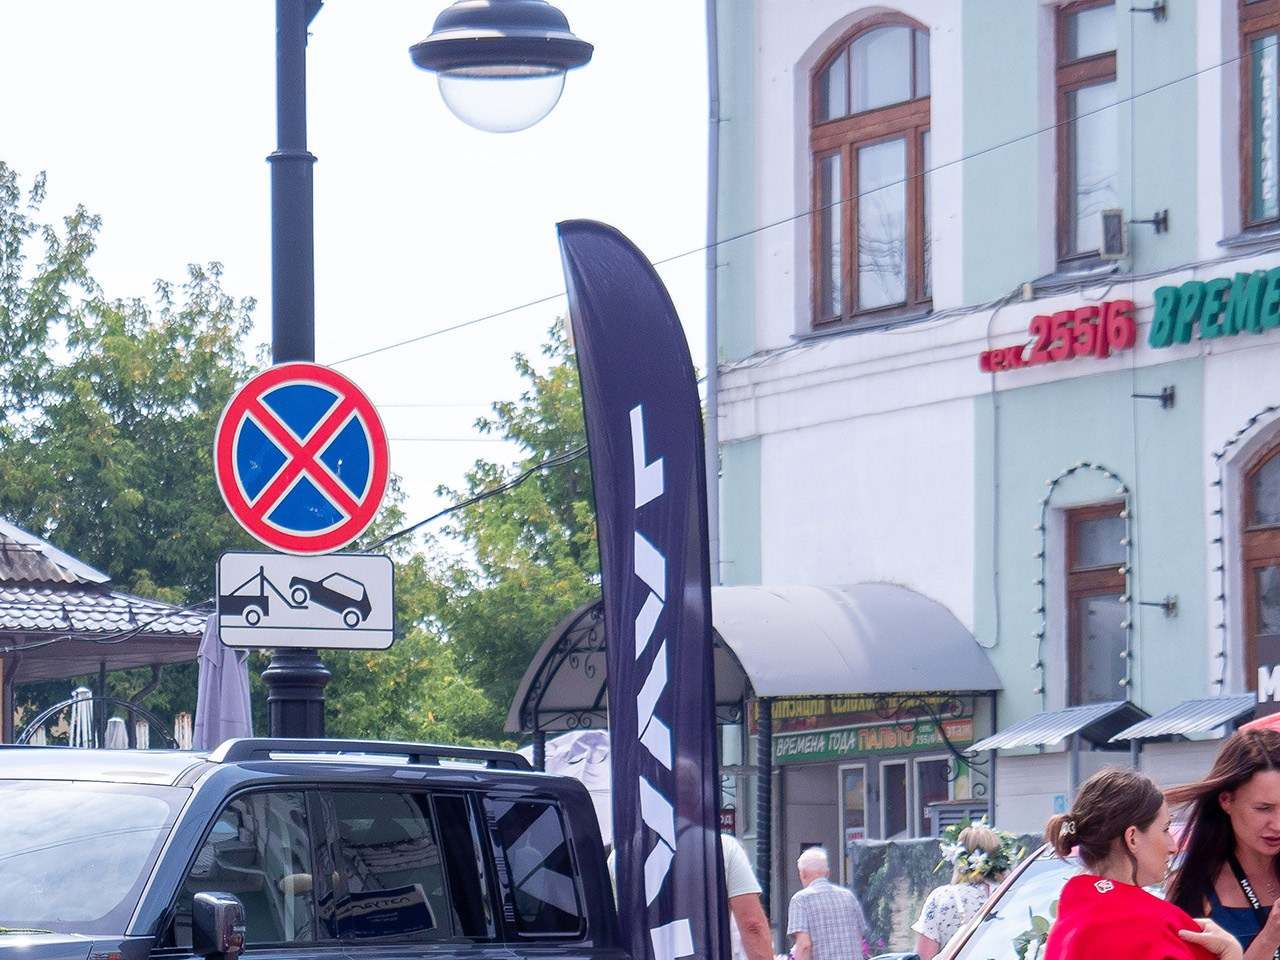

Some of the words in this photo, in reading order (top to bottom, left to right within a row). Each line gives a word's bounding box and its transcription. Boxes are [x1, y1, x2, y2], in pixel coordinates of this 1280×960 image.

[776, 735, 825, 756] ВРЕМЕНА
[829, 732, 856, 754] ГОДА
[858, 725, 914, 751] ПАЛЬТО
[1240, 879, 1260, 910] HAVAL
